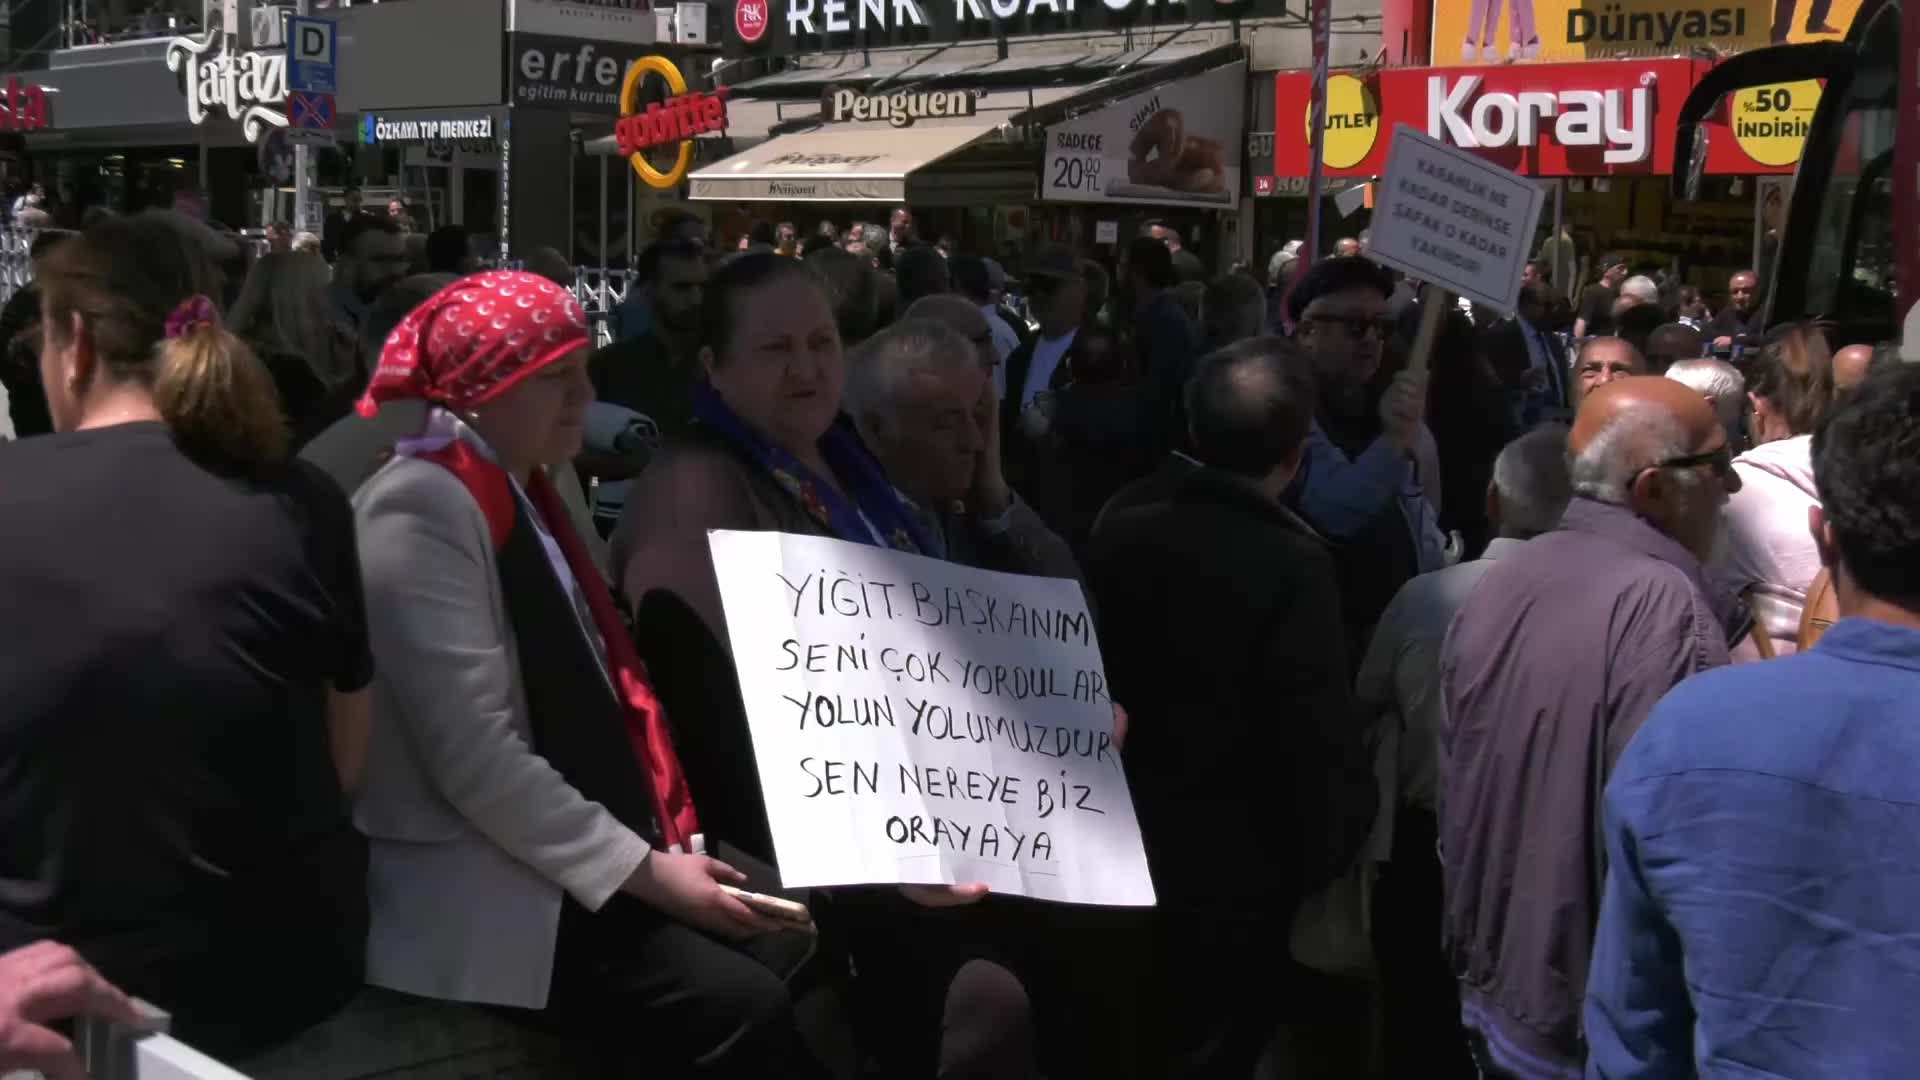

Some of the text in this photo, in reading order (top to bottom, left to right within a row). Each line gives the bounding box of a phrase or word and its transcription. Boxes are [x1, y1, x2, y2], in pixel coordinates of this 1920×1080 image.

[302, 27, 324, 56] D
[1566, 3, 1746, 47] Dünyası
[520, 45, 633, 86] erfe
[0, 72, 47, 130] ta
[570, 88, 618, 104] kurum
[833, 88, 968, 127] Penguen
[1743, 88, 1792, 112] %50
[376, 115, 491, 140] ÖZKAYA TIP MERKEZİ
[1427, 74, 1650, 164] Koray
[1057, 132, 1102, 151] SADECE
[1053, 157, 1083, 189] 20
[1459, 229, 1508, 259] KADAR
[911, 581, 1090, 647] BAŞKANIM
[775, 632, 869, 672] SENİ
[880, 647, 951, 684] ÇOK
[782, 690, 1119, 770] YOLUN YOLUMUZDUR
[800, 757, 1106, 818] SEN NEREYE BİZ
[886, 815, 1052, 861] ORAYAYA
